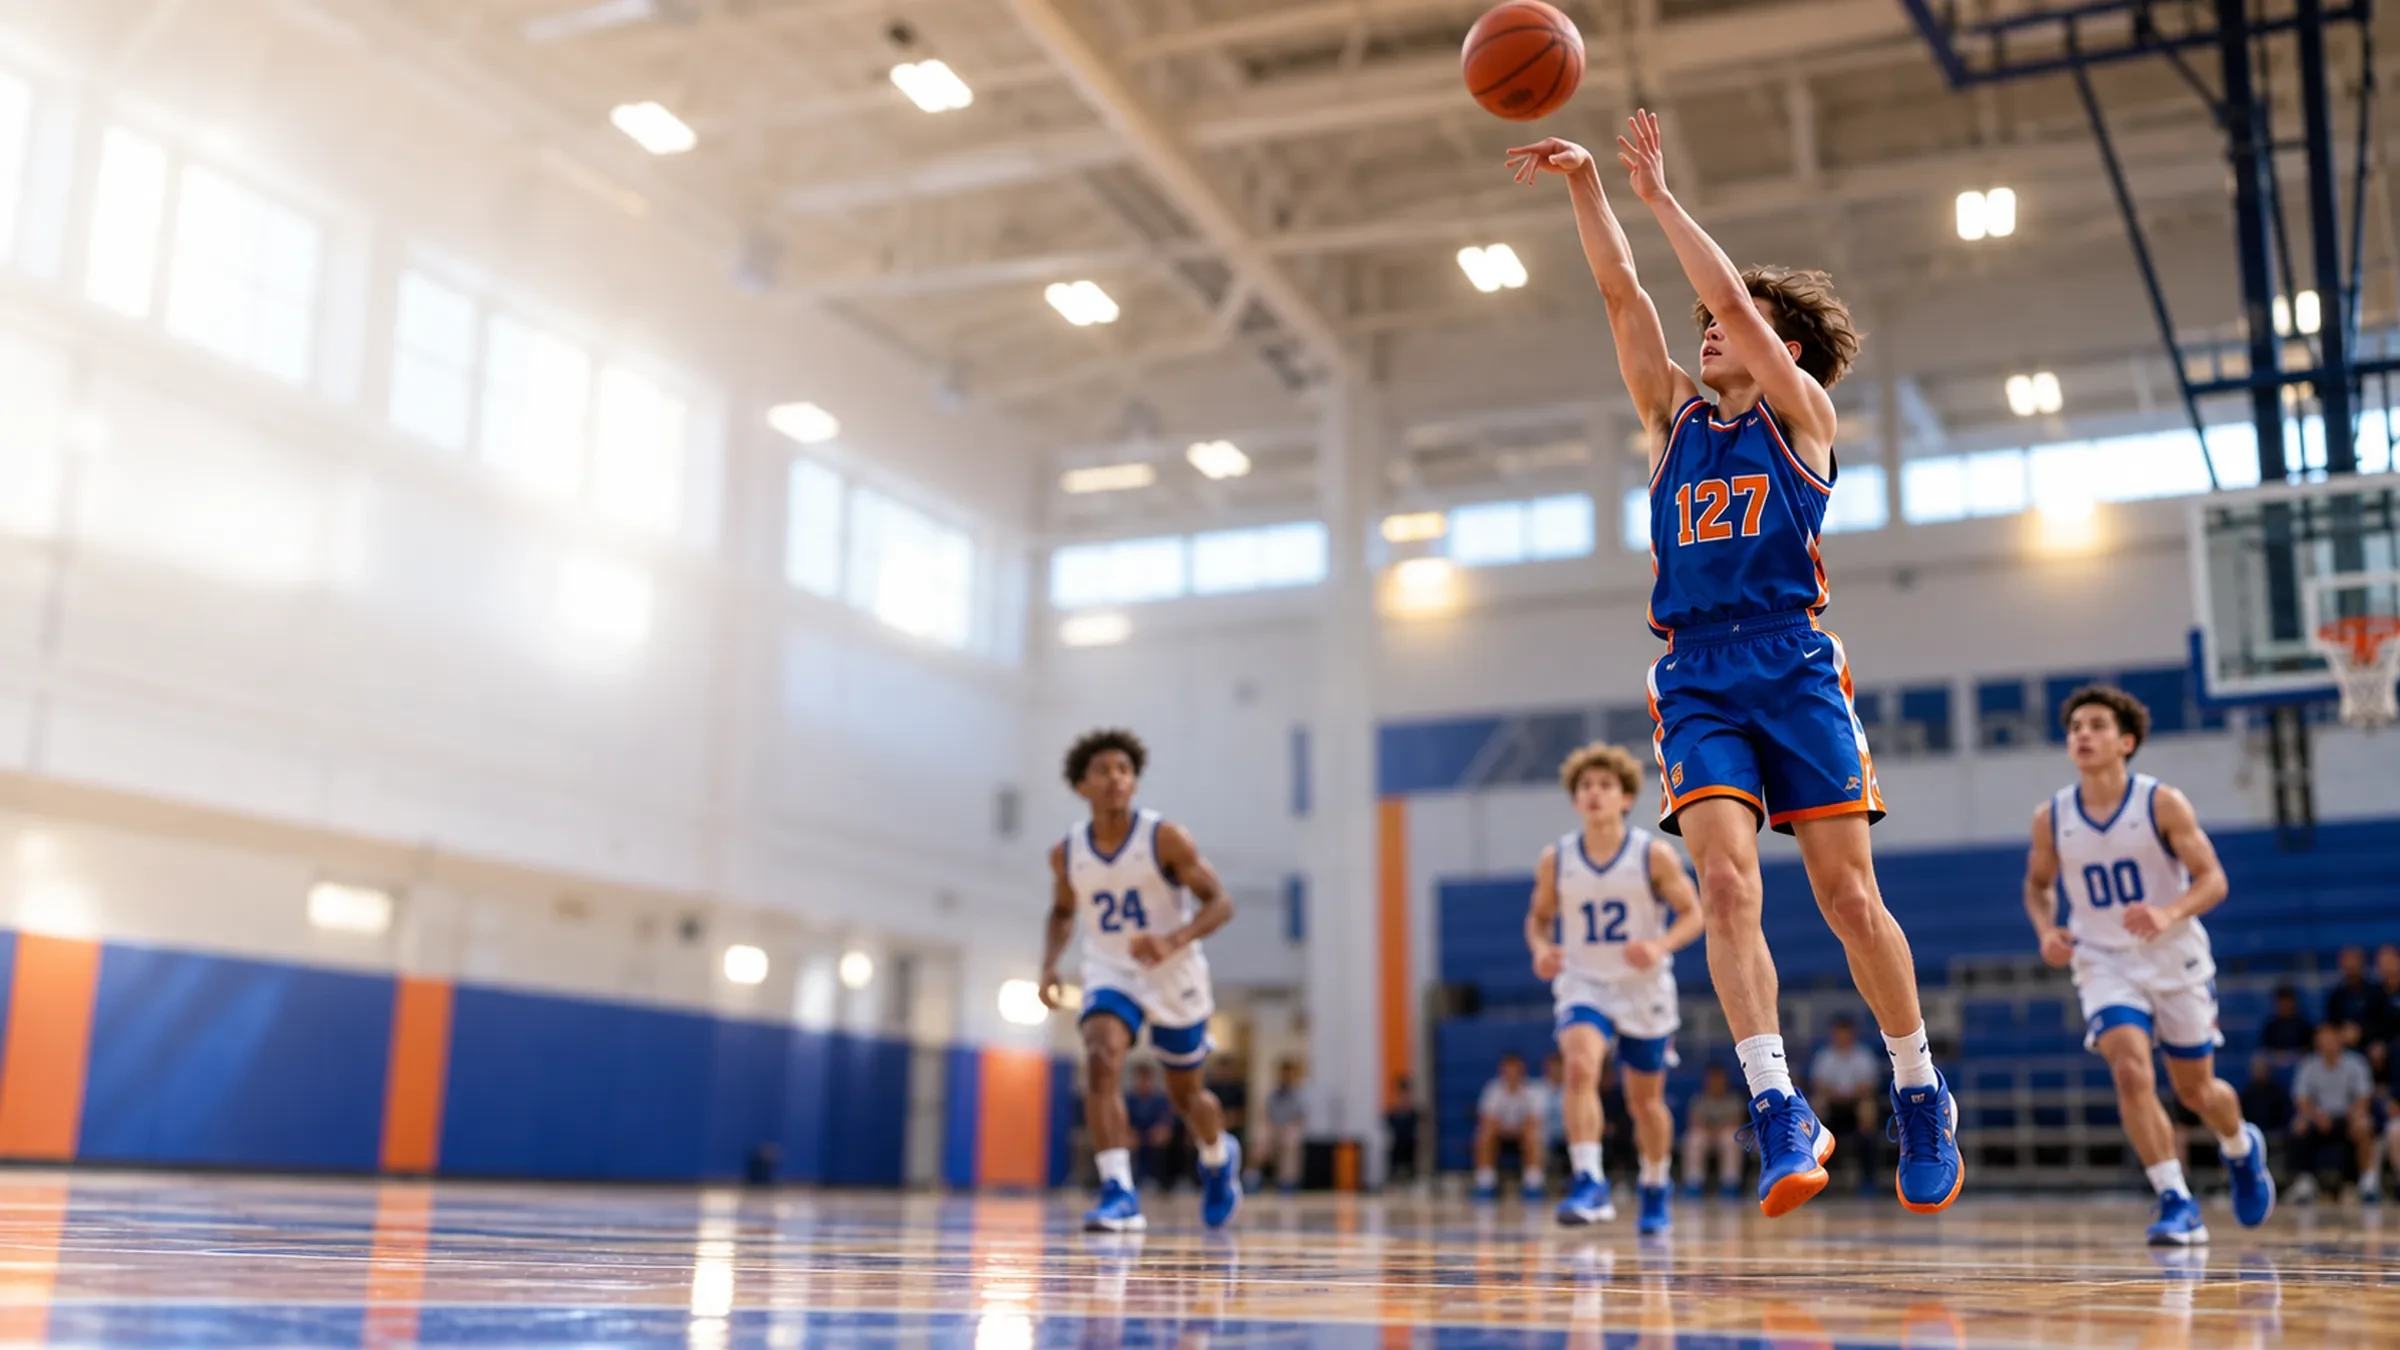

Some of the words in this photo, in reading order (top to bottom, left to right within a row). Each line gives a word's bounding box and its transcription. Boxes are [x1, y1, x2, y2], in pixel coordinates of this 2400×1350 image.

[1675, 473, 1770, 546] 127
[2083, 857, 2145, 908] 00
[1092, 887, 1148, 933] 24
[1580, 899, 1629, 943] 12
